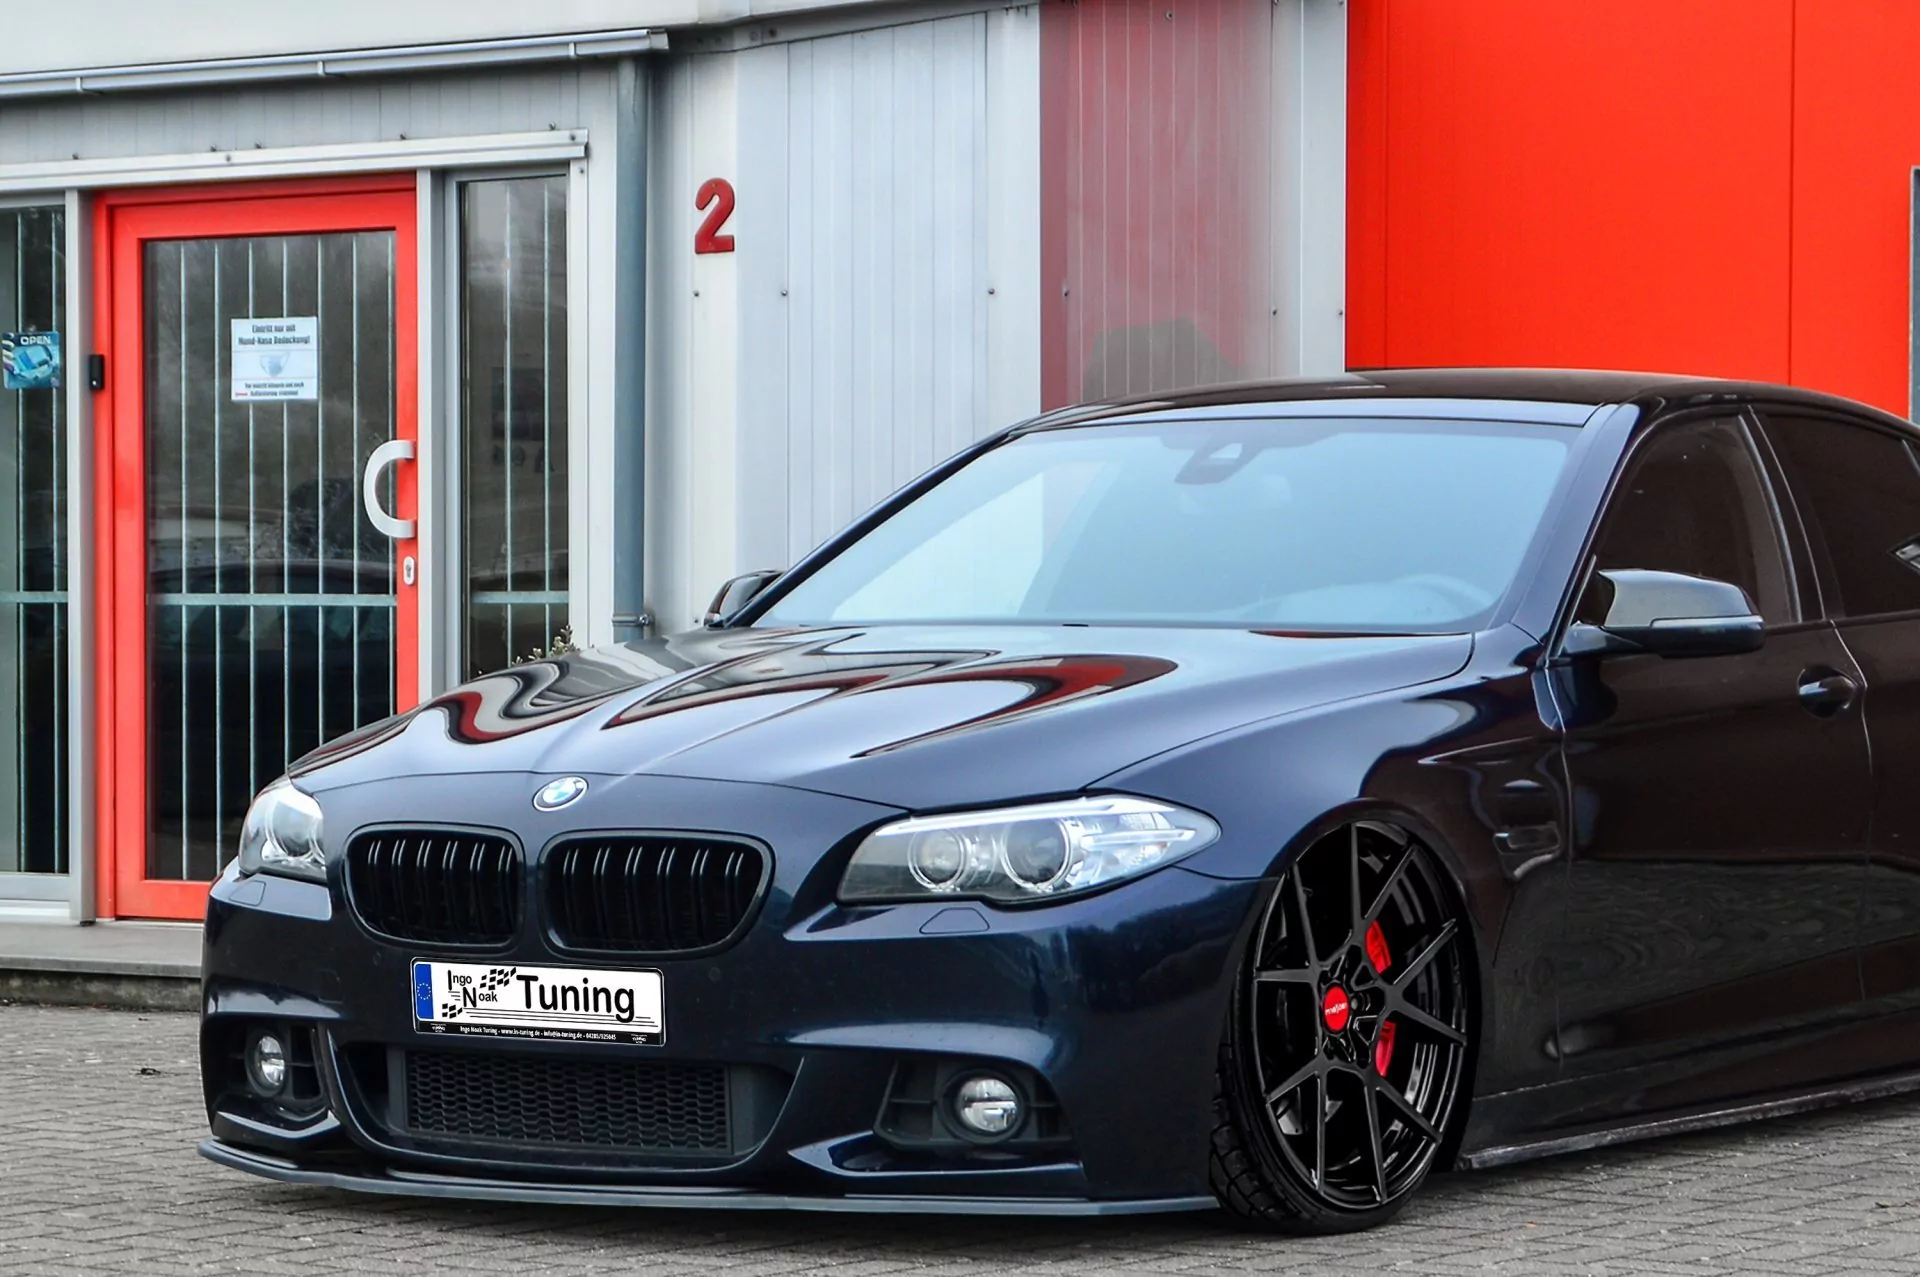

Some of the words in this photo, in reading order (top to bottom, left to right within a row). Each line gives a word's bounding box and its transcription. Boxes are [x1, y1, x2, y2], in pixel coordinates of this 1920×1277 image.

[695, 177, 736, 254] 2
[20, 335, 51, 345] OPEN
[447, 969, 472, 991] Ingo
[462, 987, 498, 1008] Noak
[516, 974, 635, 1023] Tuning
[460, 1026, 470, 1034] Ingo
[483, 1027, 498, 1036] Tuning
